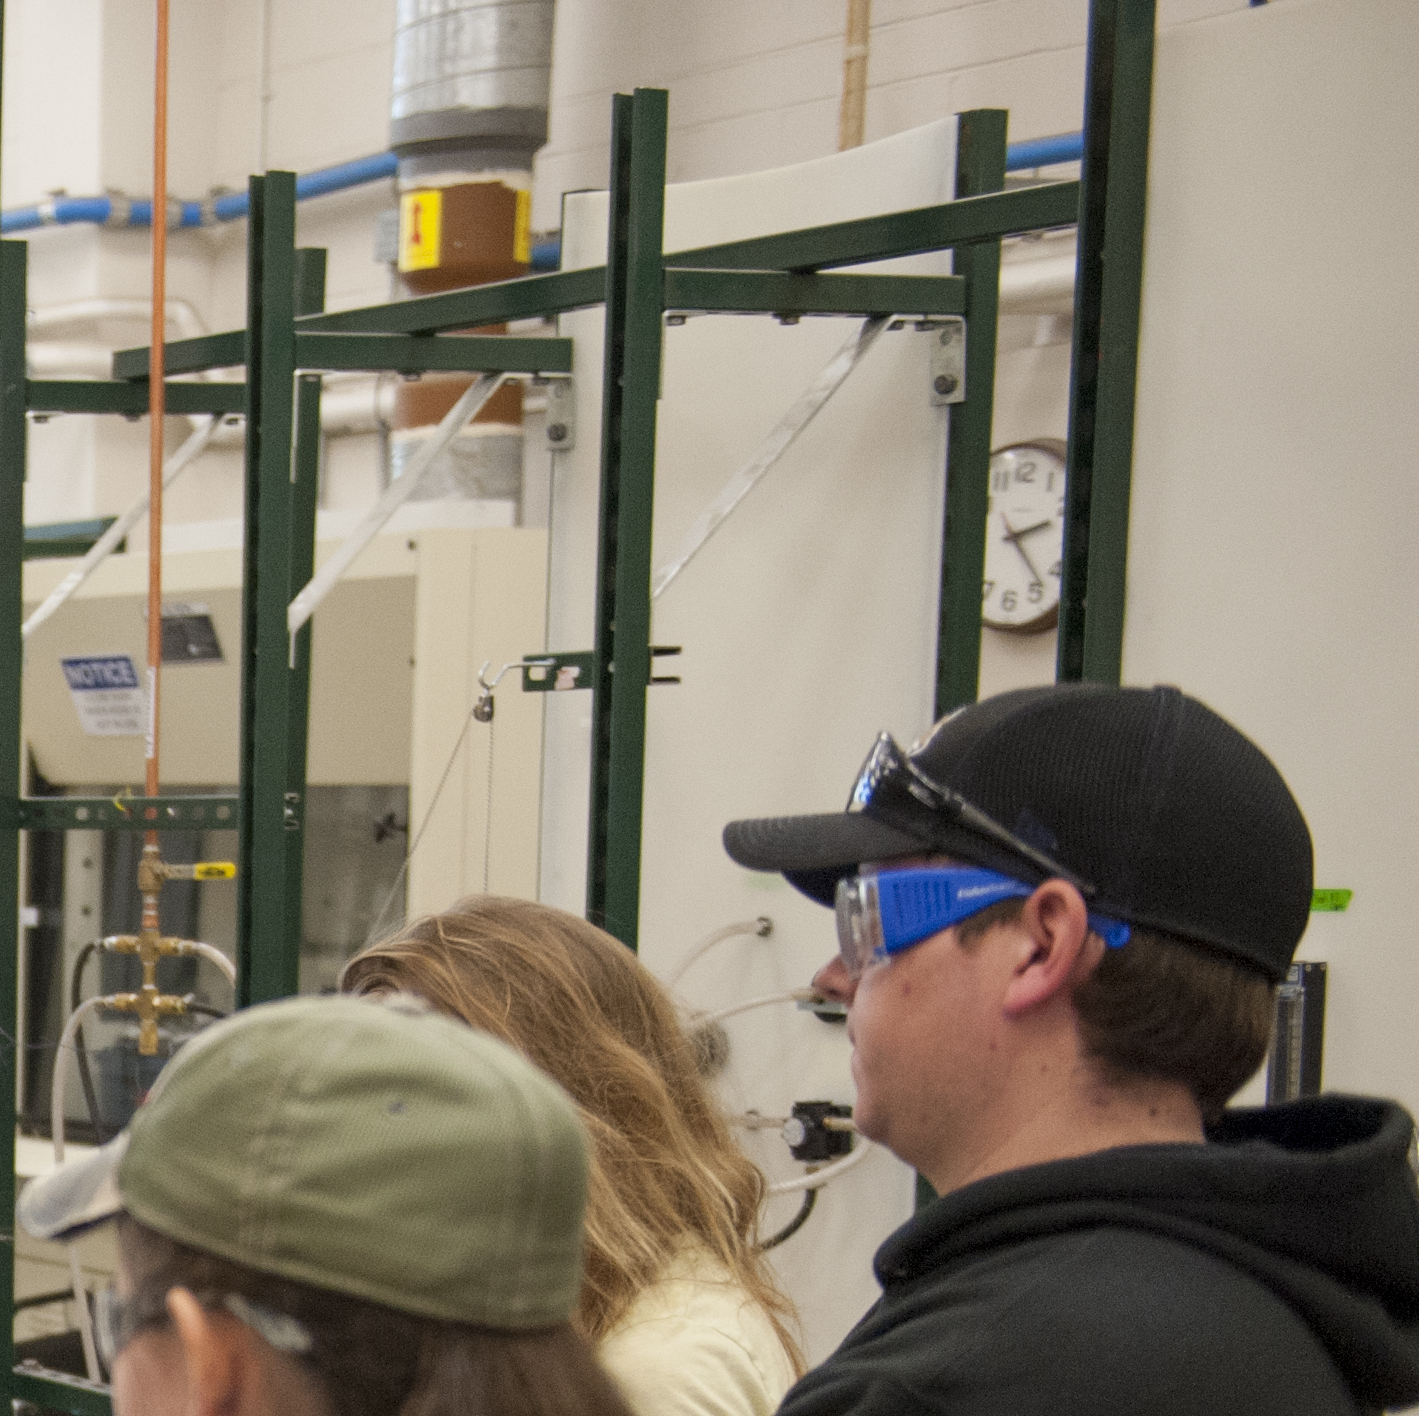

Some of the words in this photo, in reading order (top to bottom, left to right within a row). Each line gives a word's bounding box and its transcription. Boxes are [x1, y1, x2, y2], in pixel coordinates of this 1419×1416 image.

[1014, 461, 1037, 484] 12
[1000, 589, 1018, 612] 6
[1027, 580, 1045, 604] 5
[64, 660, 136, 686] NOTICE
